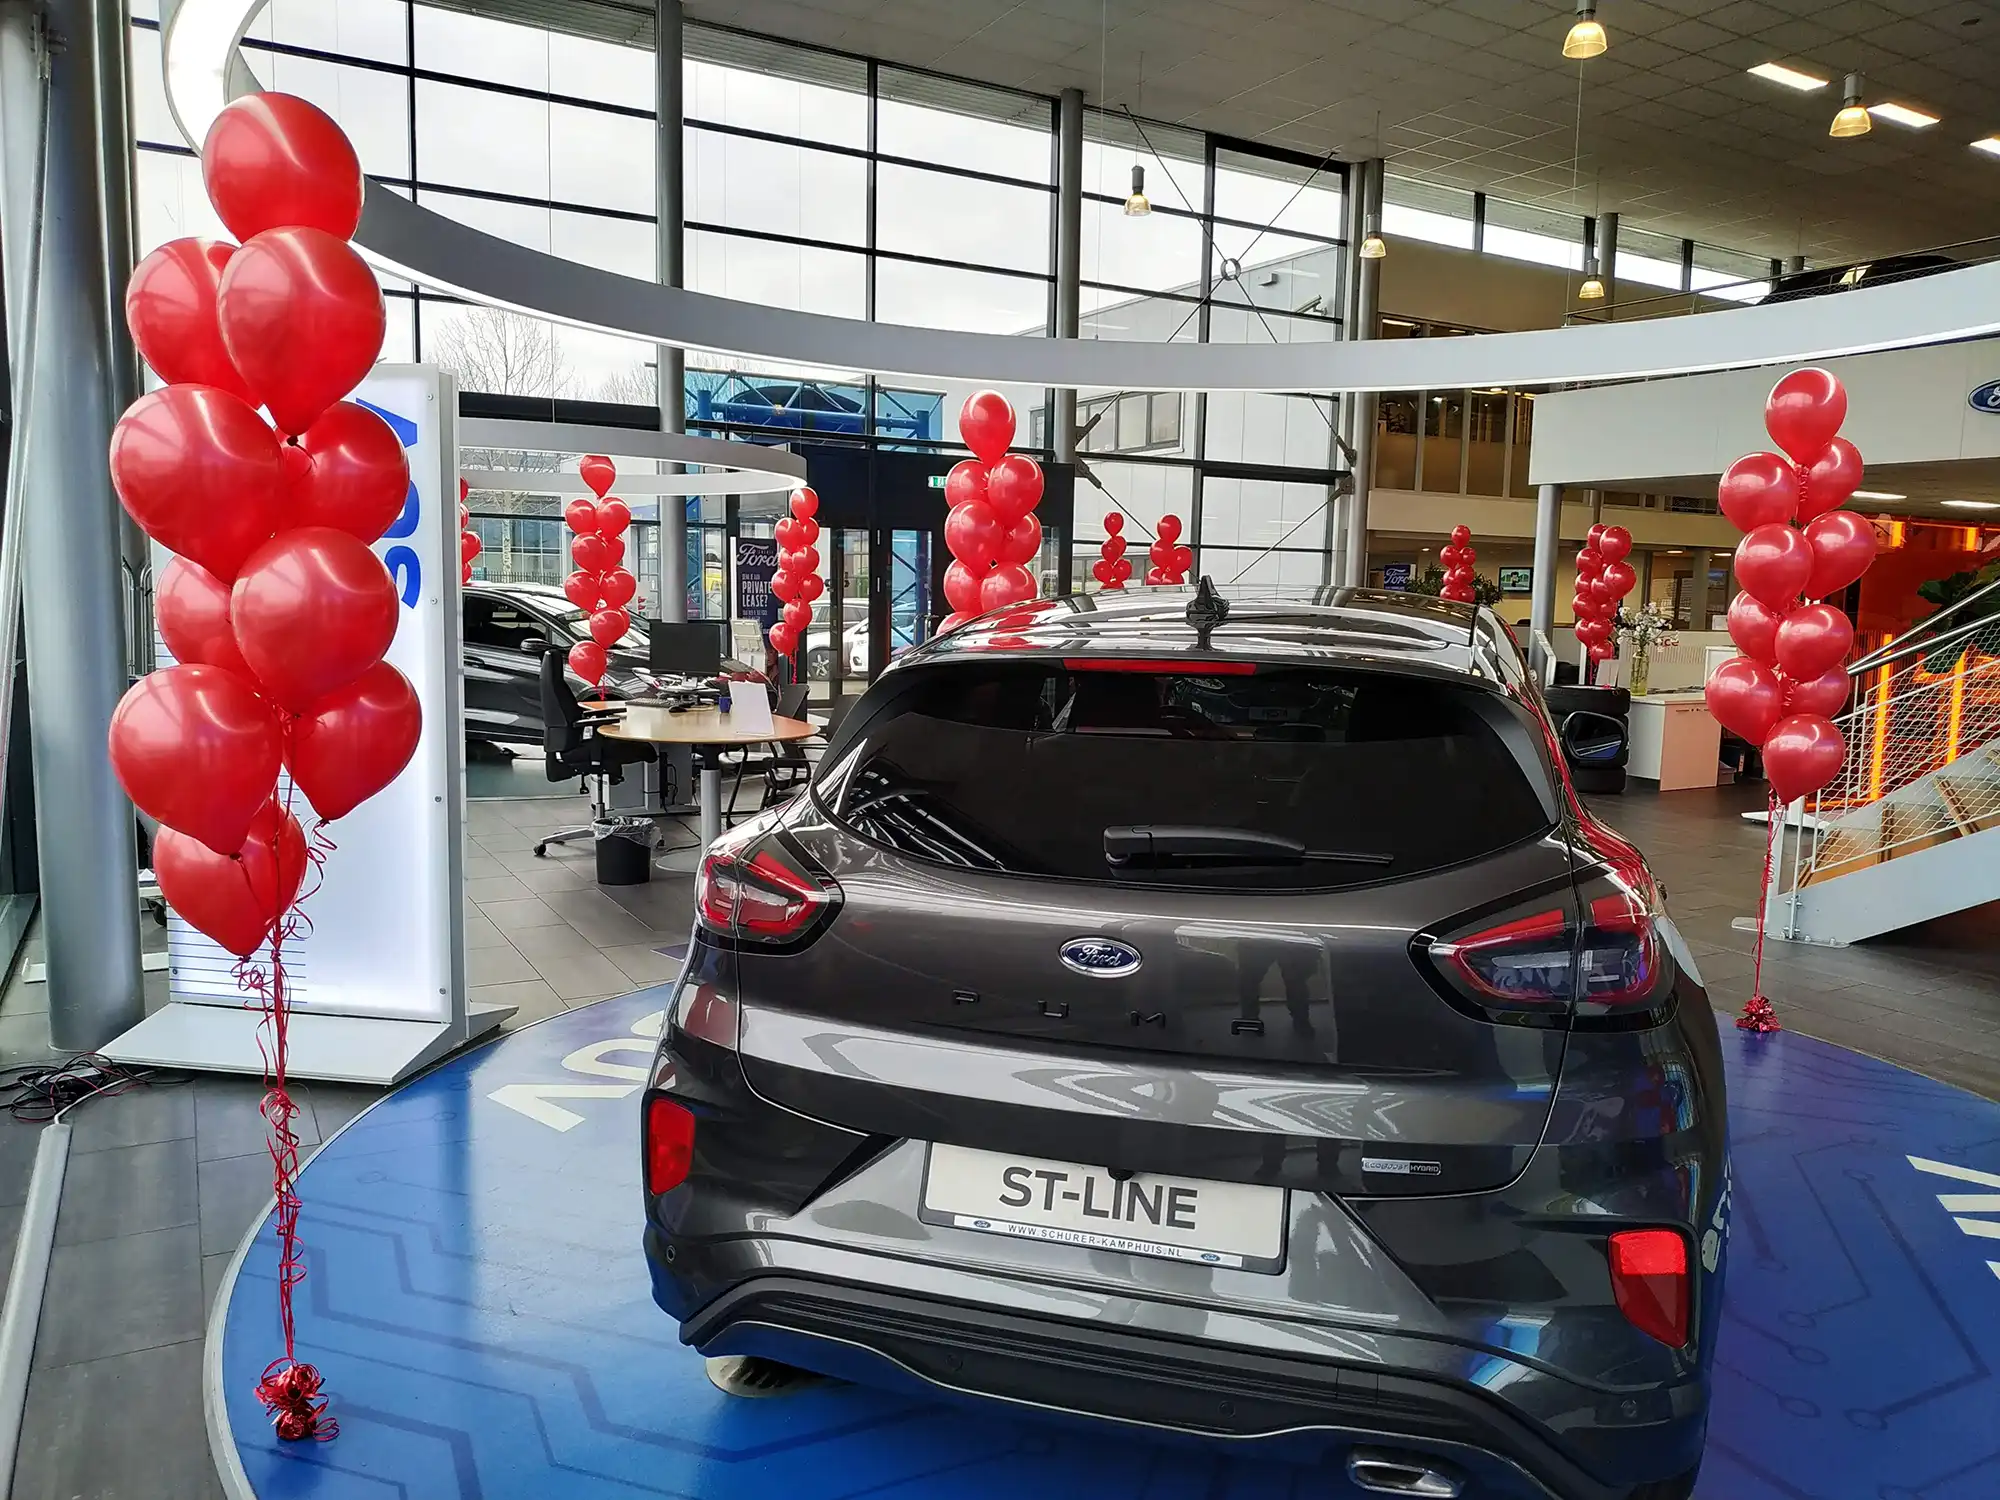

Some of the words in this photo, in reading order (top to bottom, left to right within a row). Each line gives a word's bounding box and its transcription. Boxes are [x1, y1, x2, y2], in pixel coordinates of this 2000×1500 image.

[736, 543, 779, 567] Ford
[742, 581, 772, 594] PRIVATE
[742, 595, 768, 607] LEASE?
[952, 989, 1265, 1036] PUMA
[1410, 1164, 1440, 1173] HYBRID
[998, 1166, 1199, 1230] ST-LINE
[1007, 1223, 1183, 1257] WWW.SCHURER-KAMPHUIS.NL
